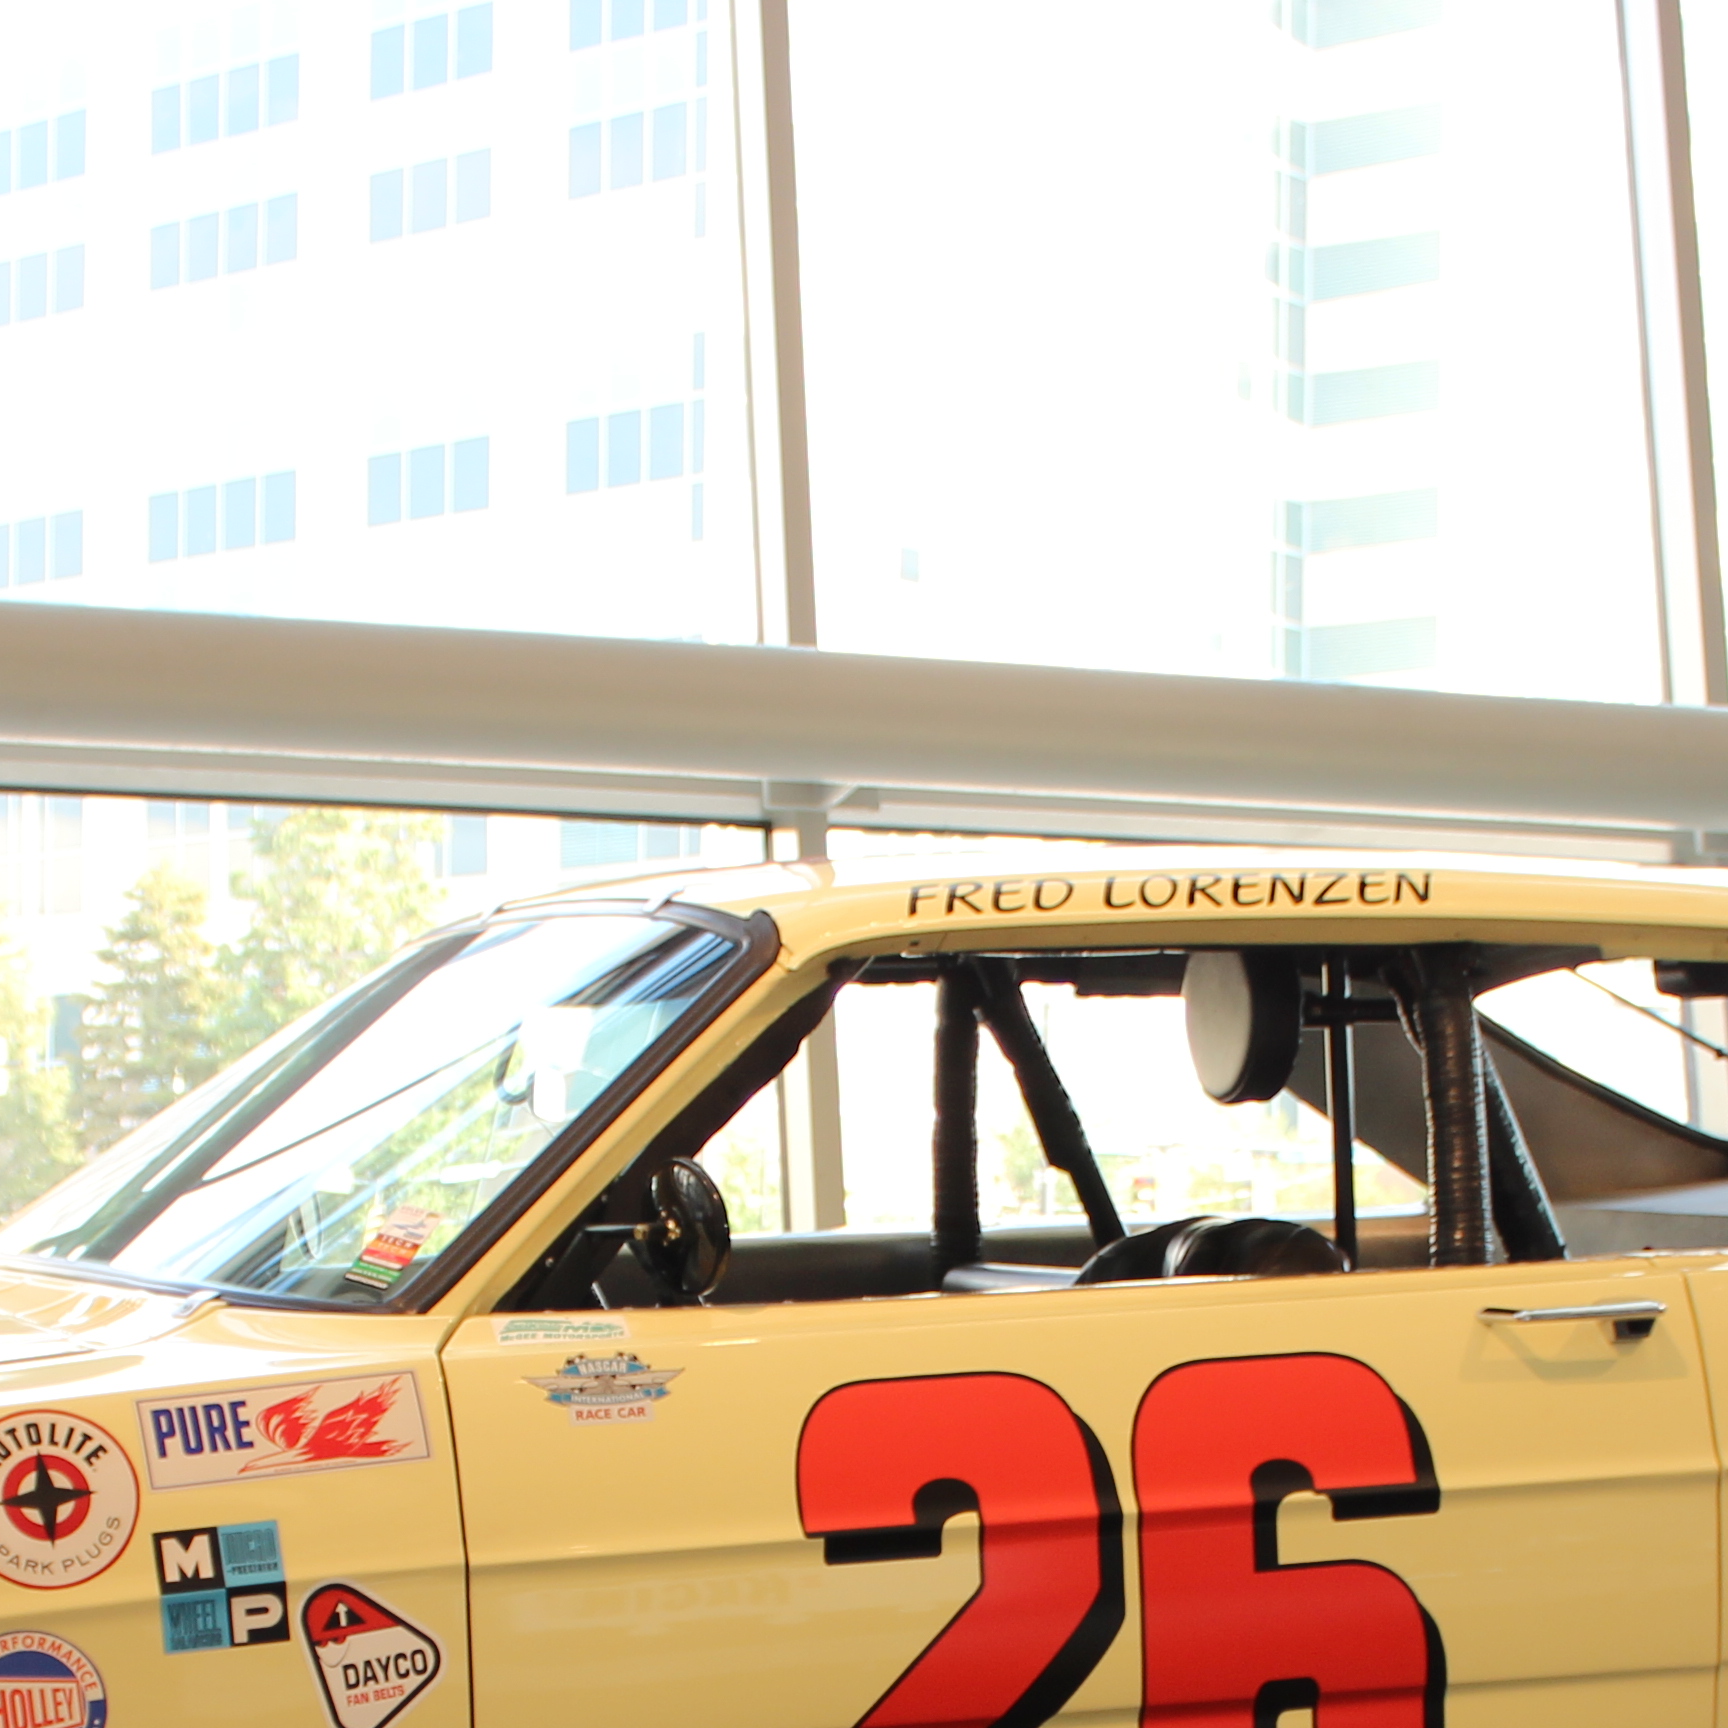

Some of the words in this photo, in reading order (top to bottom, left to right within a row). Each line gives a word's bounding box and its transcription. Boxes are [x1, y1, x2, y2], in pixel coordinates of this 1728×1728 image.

[907, 877, 1073, 917] FRED
[1102, 871, 1433, 909] LORENZEN
[577, 1360, 627, 1376] NASCAR
[151, 1400, 254, 1459] PURE
[575, 1409, 612, 1421] RACE
[618, 1407, 646, 1418] CAR
[62, 1516, 121, 1573] PLUGS
[160, 1534, 215, 1583] M
[230, 1593, 284, 1644] P
[342, 1649, 428, 1690] DAYCO
[347, 1692, 369, 1707] FAN
[374, 1685, 405, 1702] BELTS
